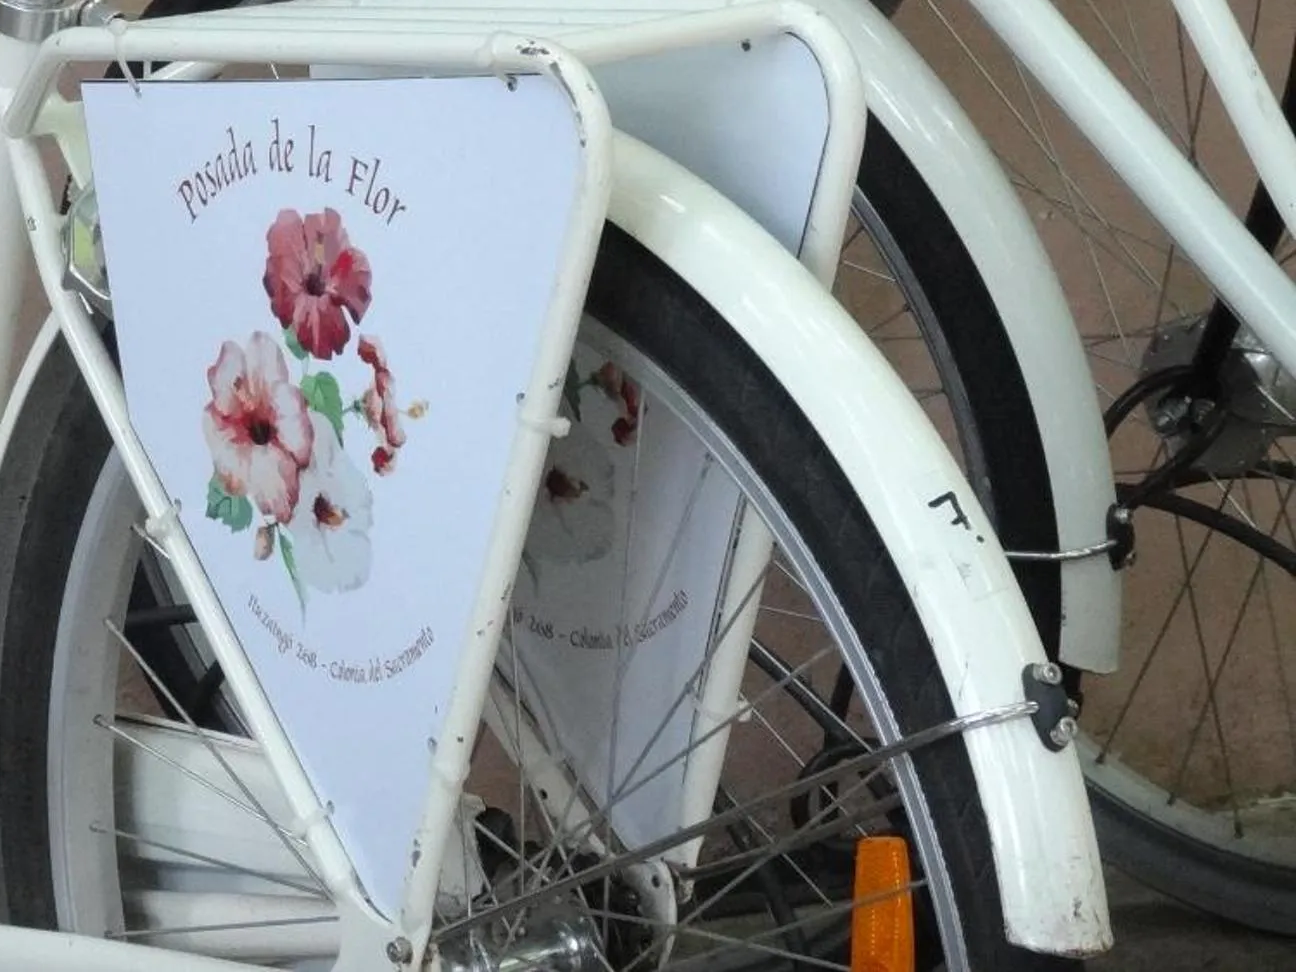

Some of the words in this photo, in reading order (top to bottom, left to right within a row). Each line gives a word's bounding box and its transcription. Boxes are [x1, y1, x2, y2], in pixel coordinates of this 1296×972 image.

[177, 126, 257, 224] Posada
[268, 118, 294, 173] de
[308, 124, 333, 183] la
[346, 156, 406, 226] Flor
